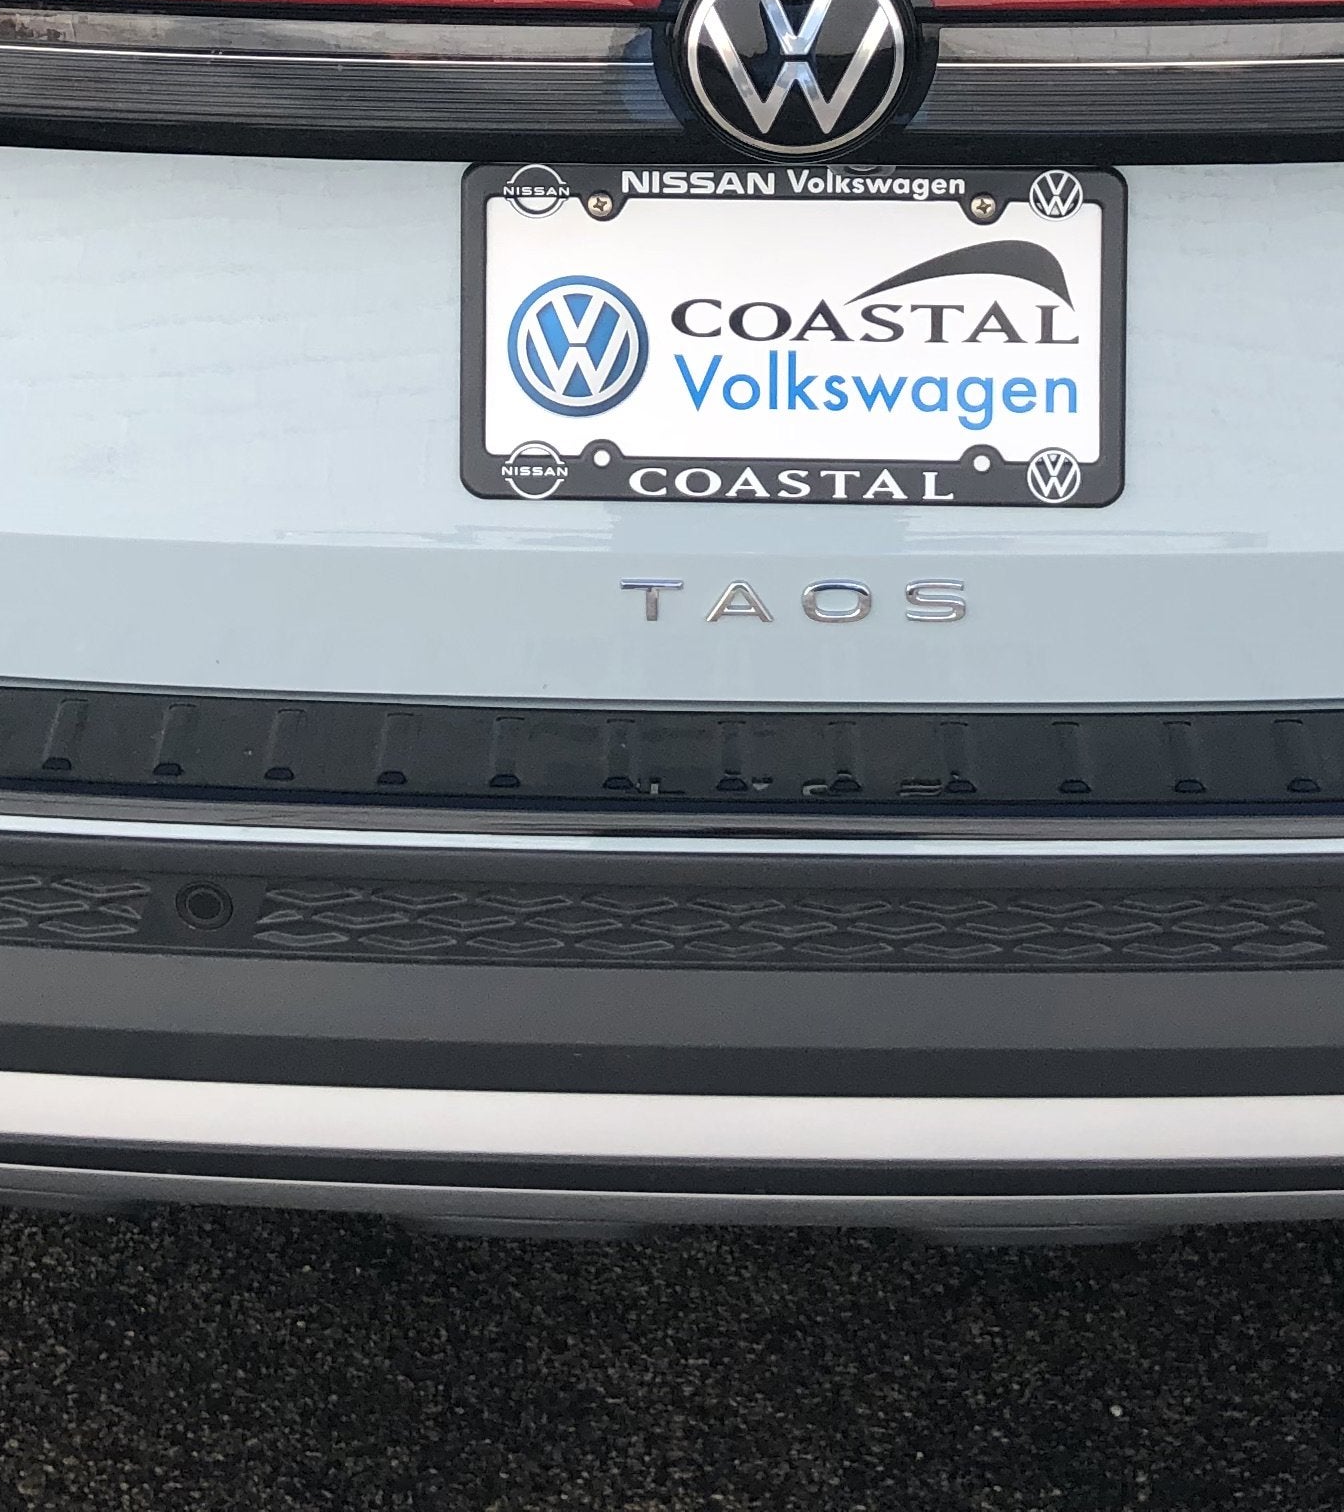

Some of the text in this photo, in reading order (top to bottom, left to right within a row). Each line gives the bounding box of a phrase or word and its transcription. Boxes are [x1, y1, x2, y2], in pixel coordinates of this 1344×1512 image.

[503, 186, 570, 197] NISSAN
[621, 169, 966, 200] NISSAN Volkswagen
[670, 298, 1080, 345] COASTAL
[674, 350, 1078, 431] Volkswagen
[501, 464, 569, 479] NISSAN
[628, 466, 954, 501] COASTAL
[619, 577, 968, 623] TAOS
